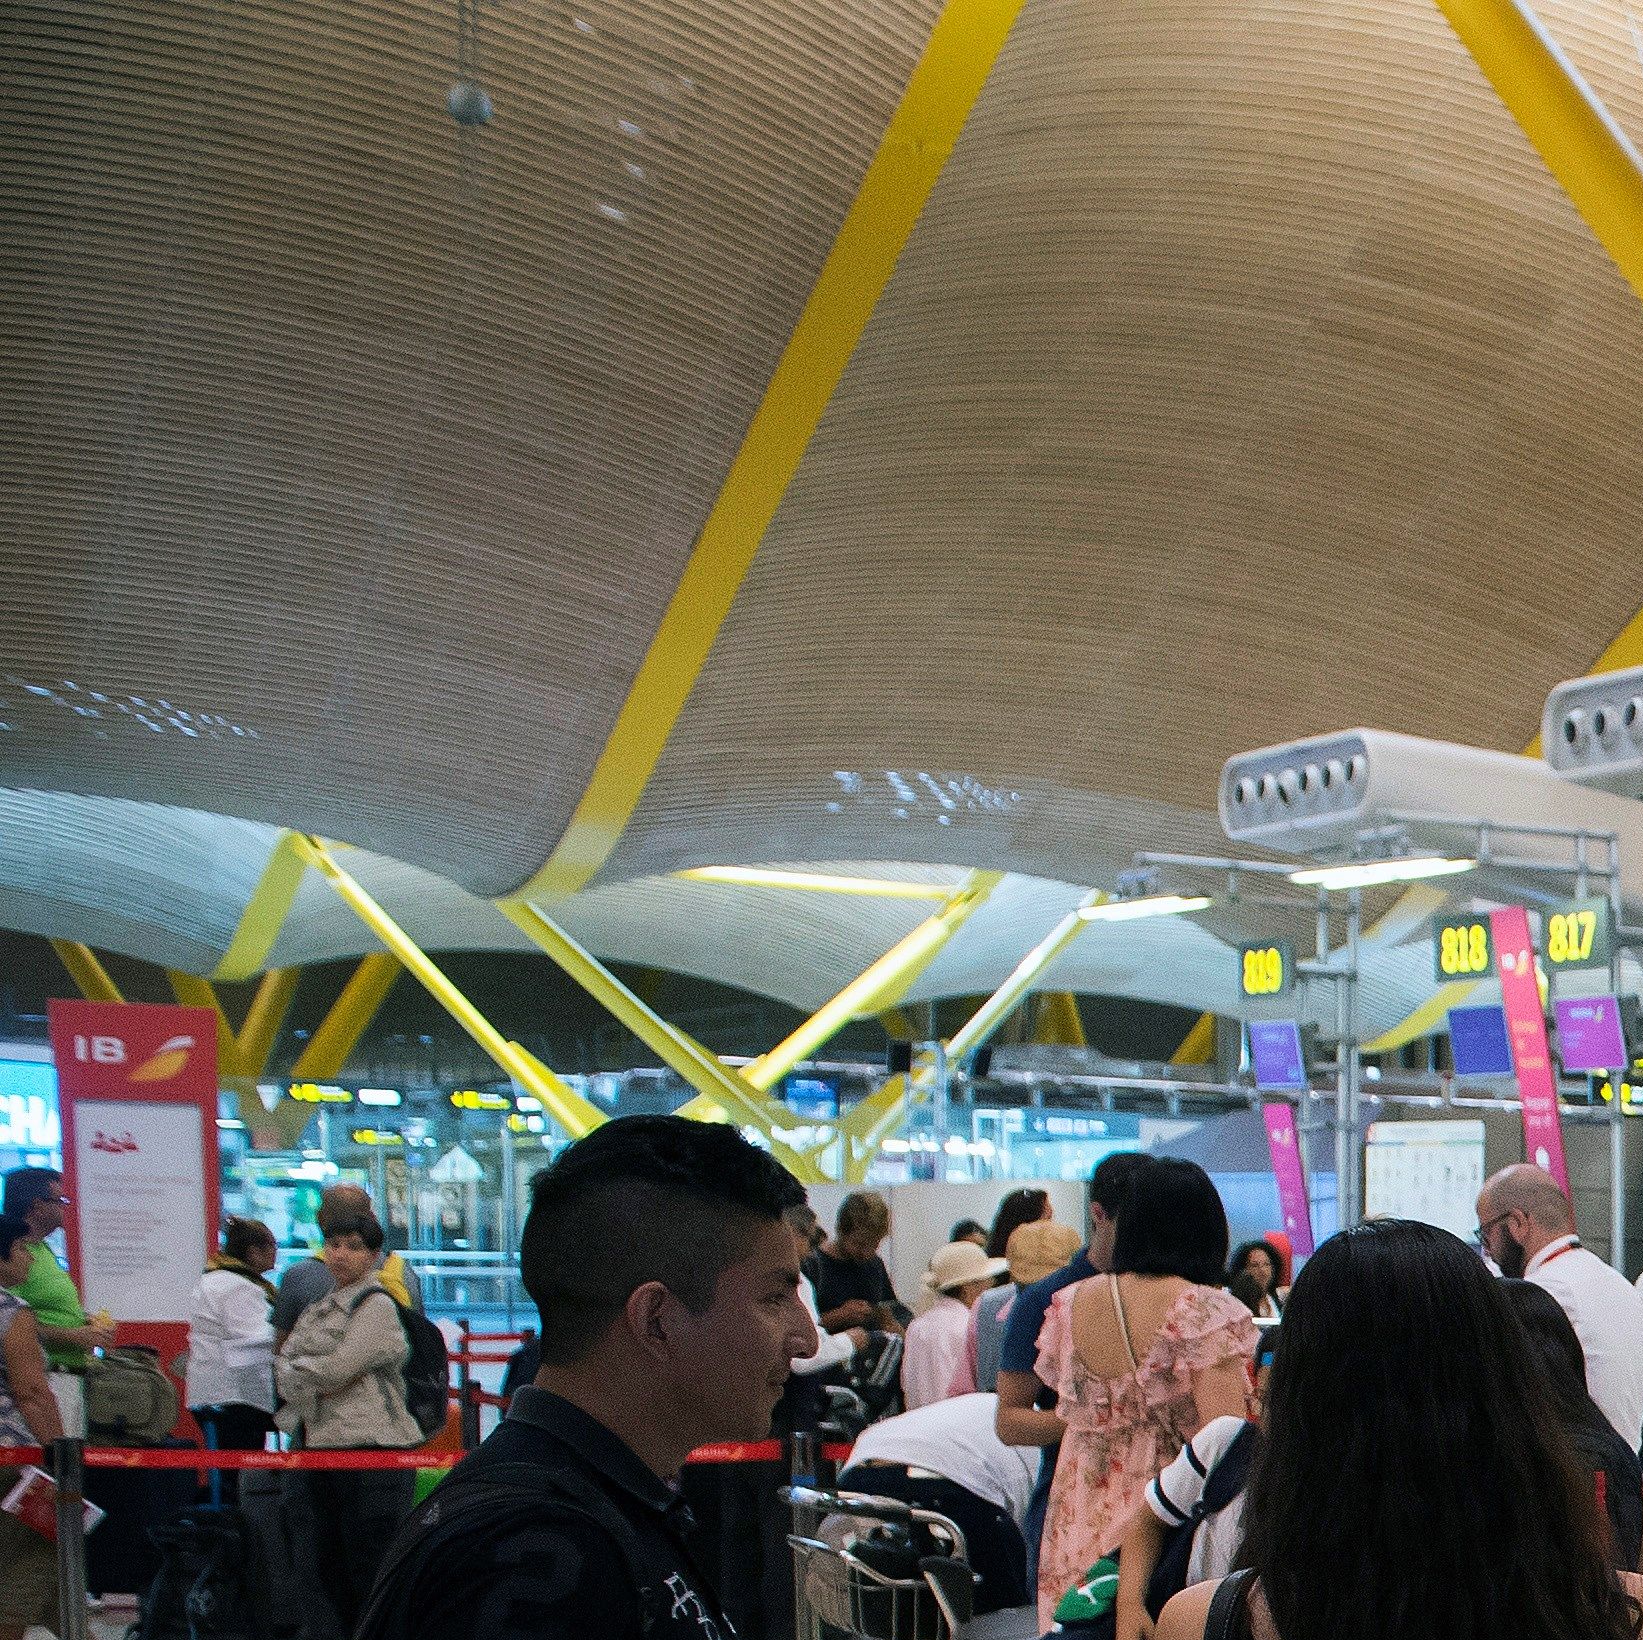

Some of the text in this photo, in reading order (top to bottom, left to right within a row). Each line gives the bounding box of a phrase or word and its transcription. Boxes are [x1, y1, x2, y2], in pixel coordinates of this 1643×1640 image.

[1441, 923, 1489, 975] 818
[1548, 910, 1597, 965] 817
[73, 1034, 127, 1064] IB
